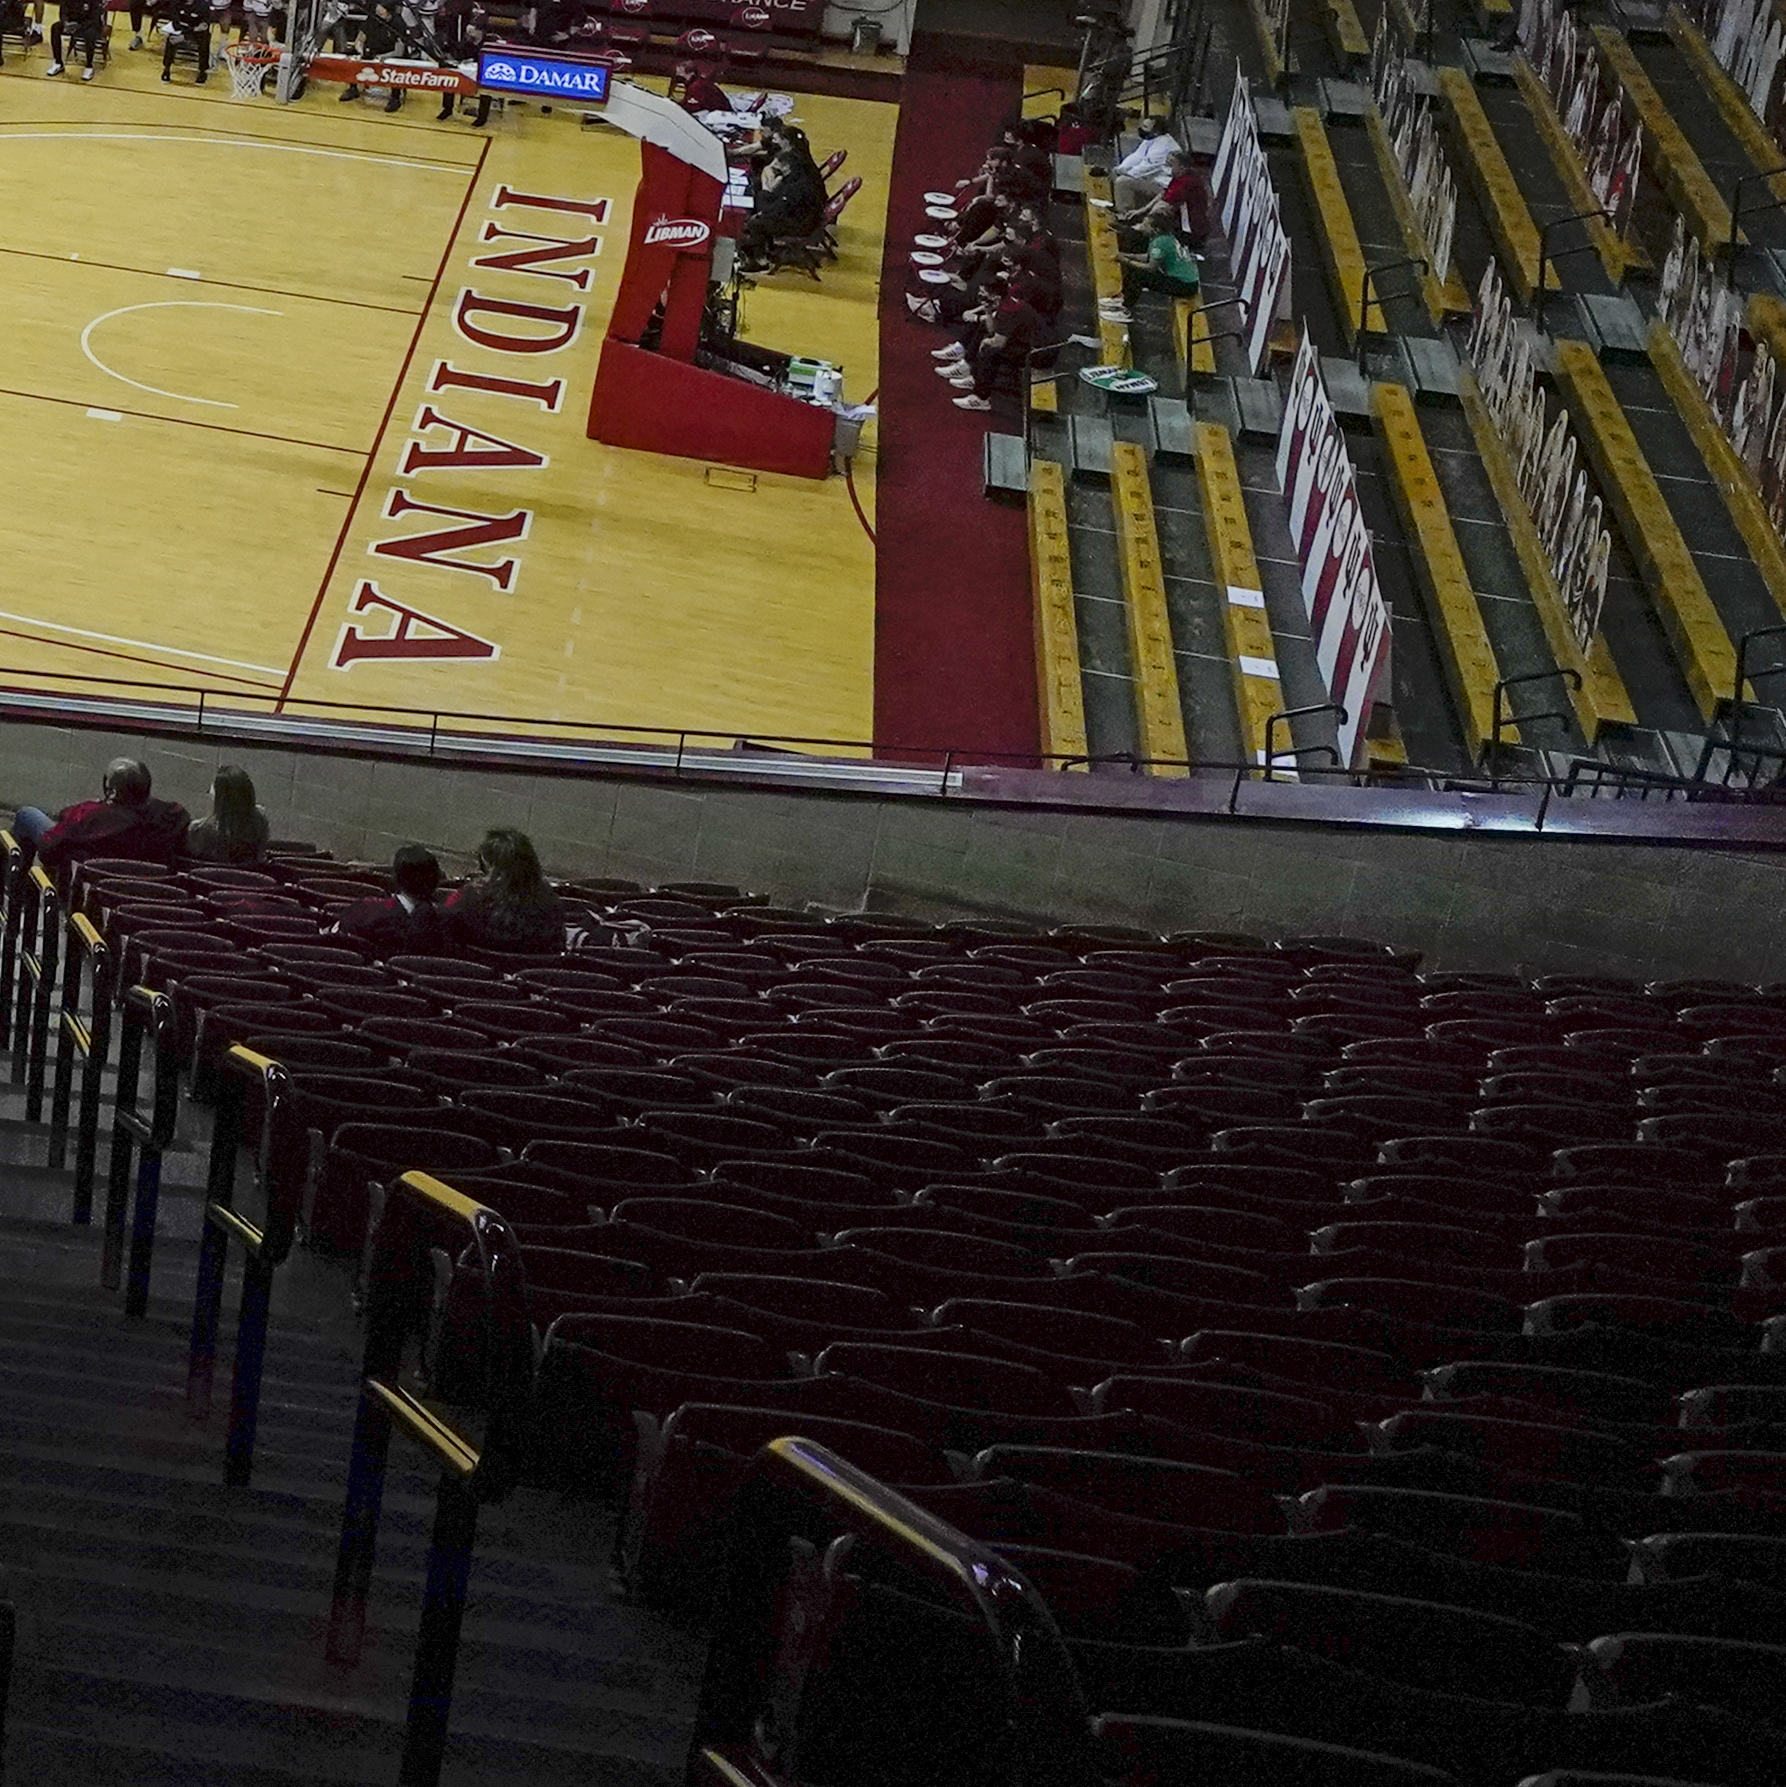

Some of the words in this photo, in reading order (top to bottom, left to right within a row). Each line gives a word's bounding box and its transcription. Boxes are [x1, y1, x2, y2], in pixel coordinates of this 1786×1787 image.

[379, 67, 460, 88] StateFarm
[519, 65, 602, 93] DAMAR
[644, 220, 707, 246] LIBMAN
[327, 183, 614, 671] INDIANA
